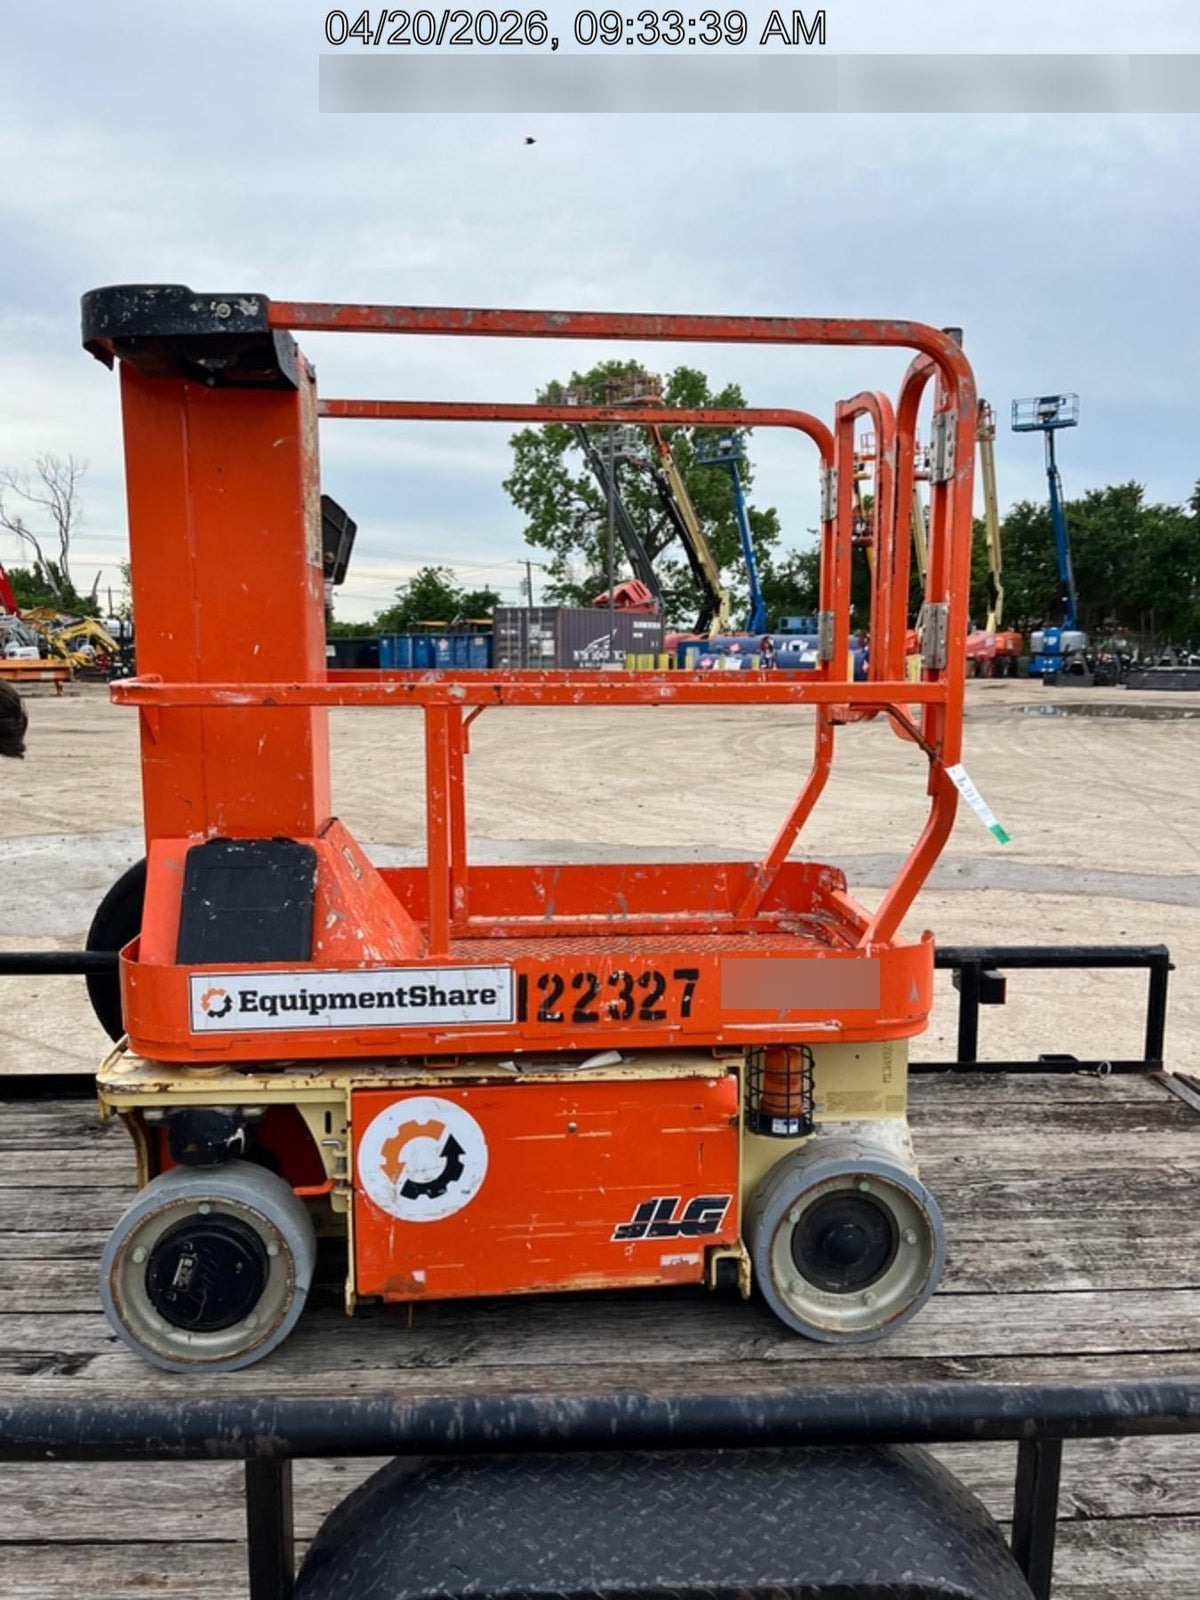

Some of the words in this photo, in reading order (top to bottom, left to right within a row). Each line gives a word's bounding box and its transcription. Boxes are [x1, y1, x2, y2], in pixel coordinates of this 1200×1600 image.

[238, 985, 497, 1016] EquipmentShare
[517, 968, 699, 1023] 122327
[610, 1194, 733, 1241] JLG
